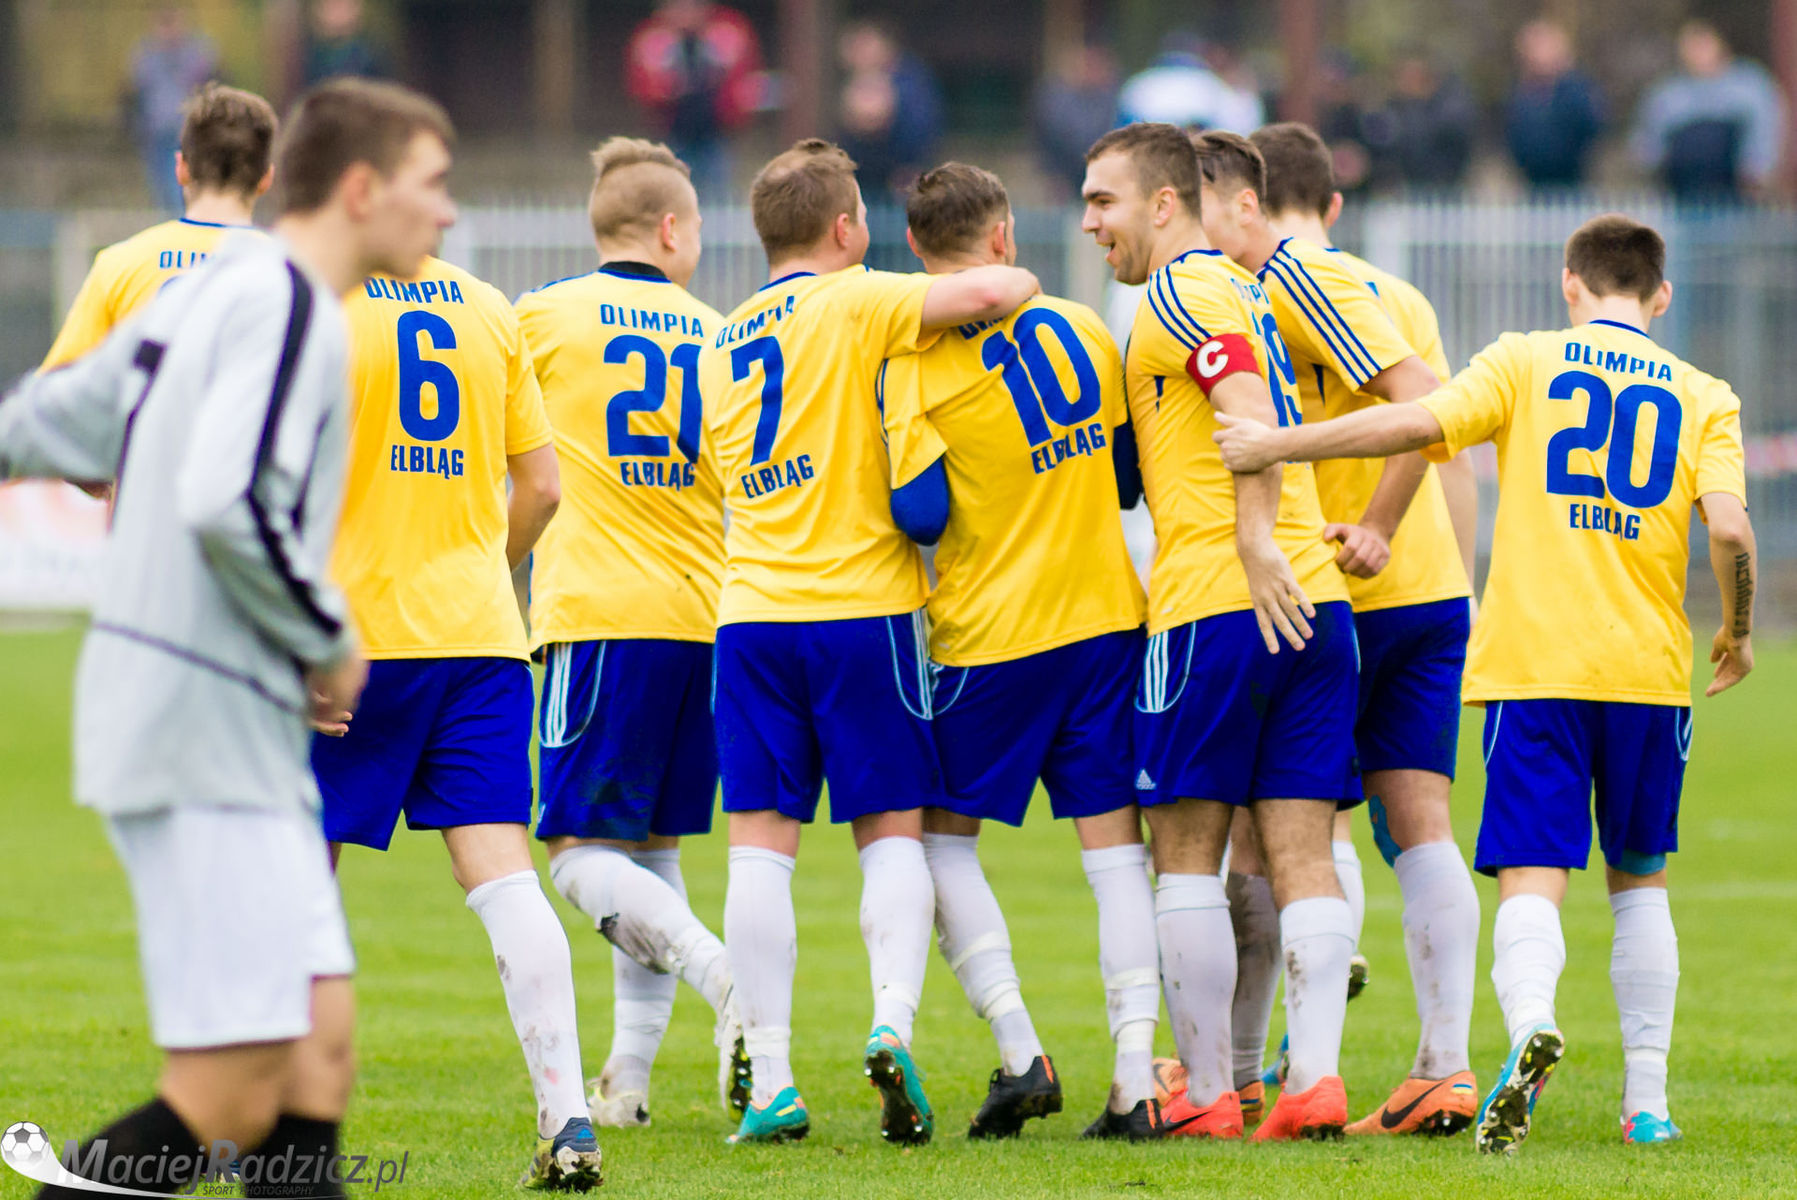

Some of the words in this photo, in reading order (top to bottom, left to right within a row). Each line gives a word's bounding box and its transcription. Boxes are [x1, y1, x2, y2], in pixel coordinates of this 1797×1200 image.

[363, 277, 464, 304] OLIMPIA
[600, 304, 704, 338] OLIMPIA
[397, 310, 460, 442] 6
[981, 307, 1101, 448] 10
[1196, 340, 1229, 378] C
[1564, 342, 1672, 382] OLIMPIA
[603, 334, 703, 464] 21
[730, 335, 784, 467] 7
[1031, 423, 1106, 474] ELBLĄG
[1546, 370, 1683, 508] 20
[390, 445, 464, 479] ELBLĄG
[619, 461, 696, 492] ELBLĄG
[741, 454, 814, 499] ELBLĄG
[1569, 503, 1641, 541] ELBLĄG
